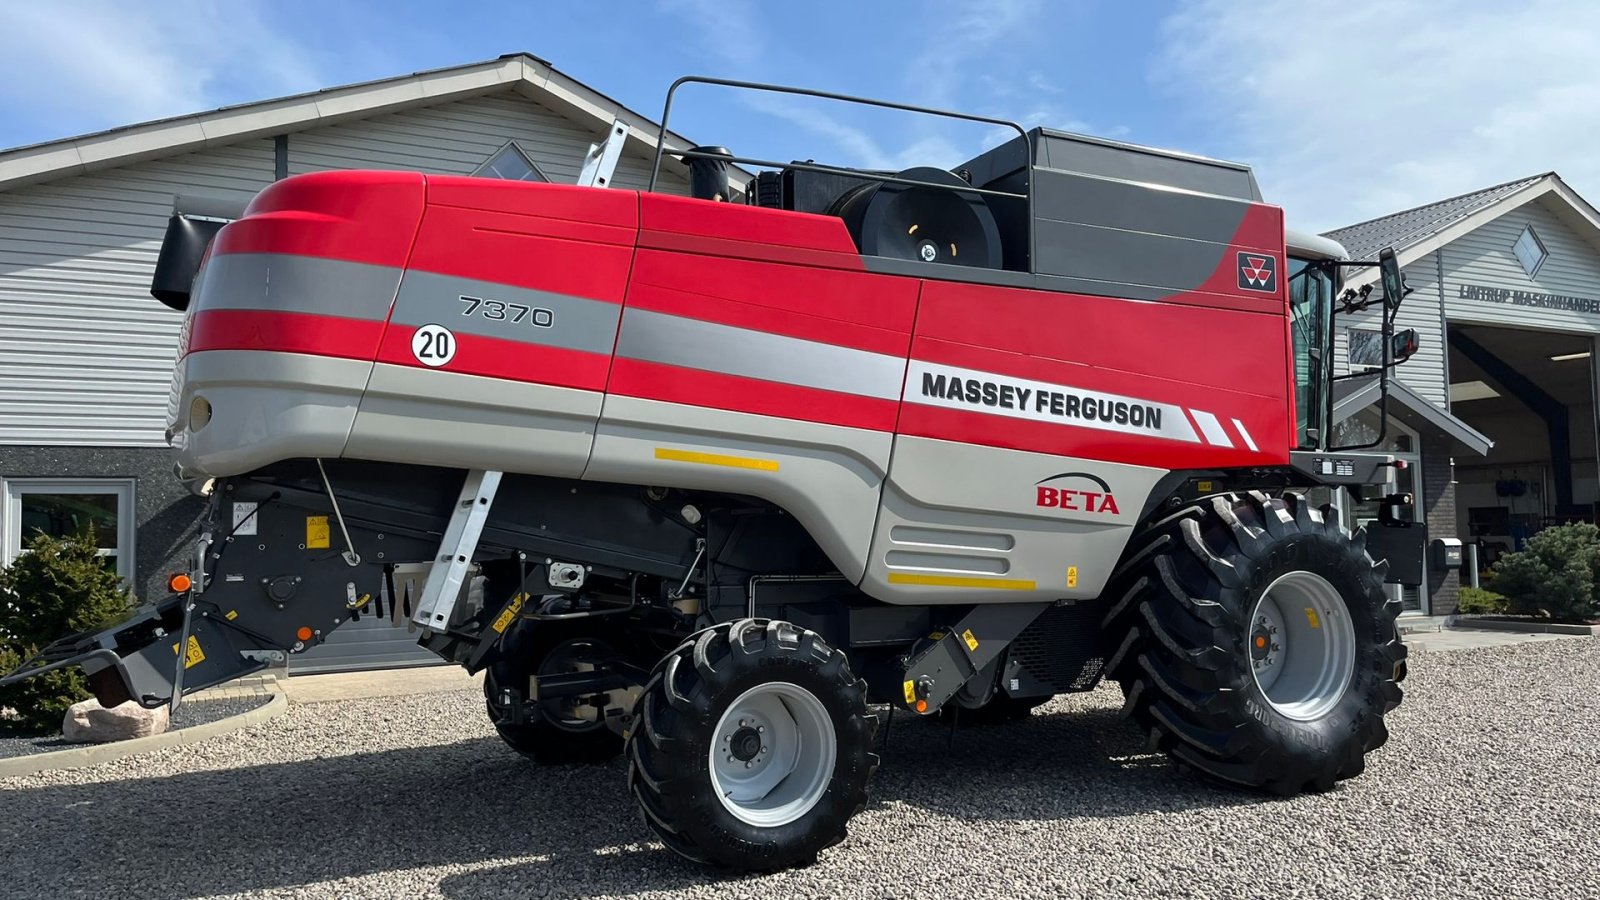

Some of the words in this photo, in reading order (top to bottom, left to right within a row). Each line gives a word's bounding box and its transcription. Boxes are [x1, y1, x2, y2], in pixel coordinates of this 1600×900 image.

[1460, 284, 1510, 303] LINTRUP
[459, 295, 555, 328] 7370
[419, 331, 449, 359] 20
[922, 372, 1031, 411] MASSEY
[1035, 390, 1162, 430] FERGUSON
[1036, 486, 1120, 515] BETA
